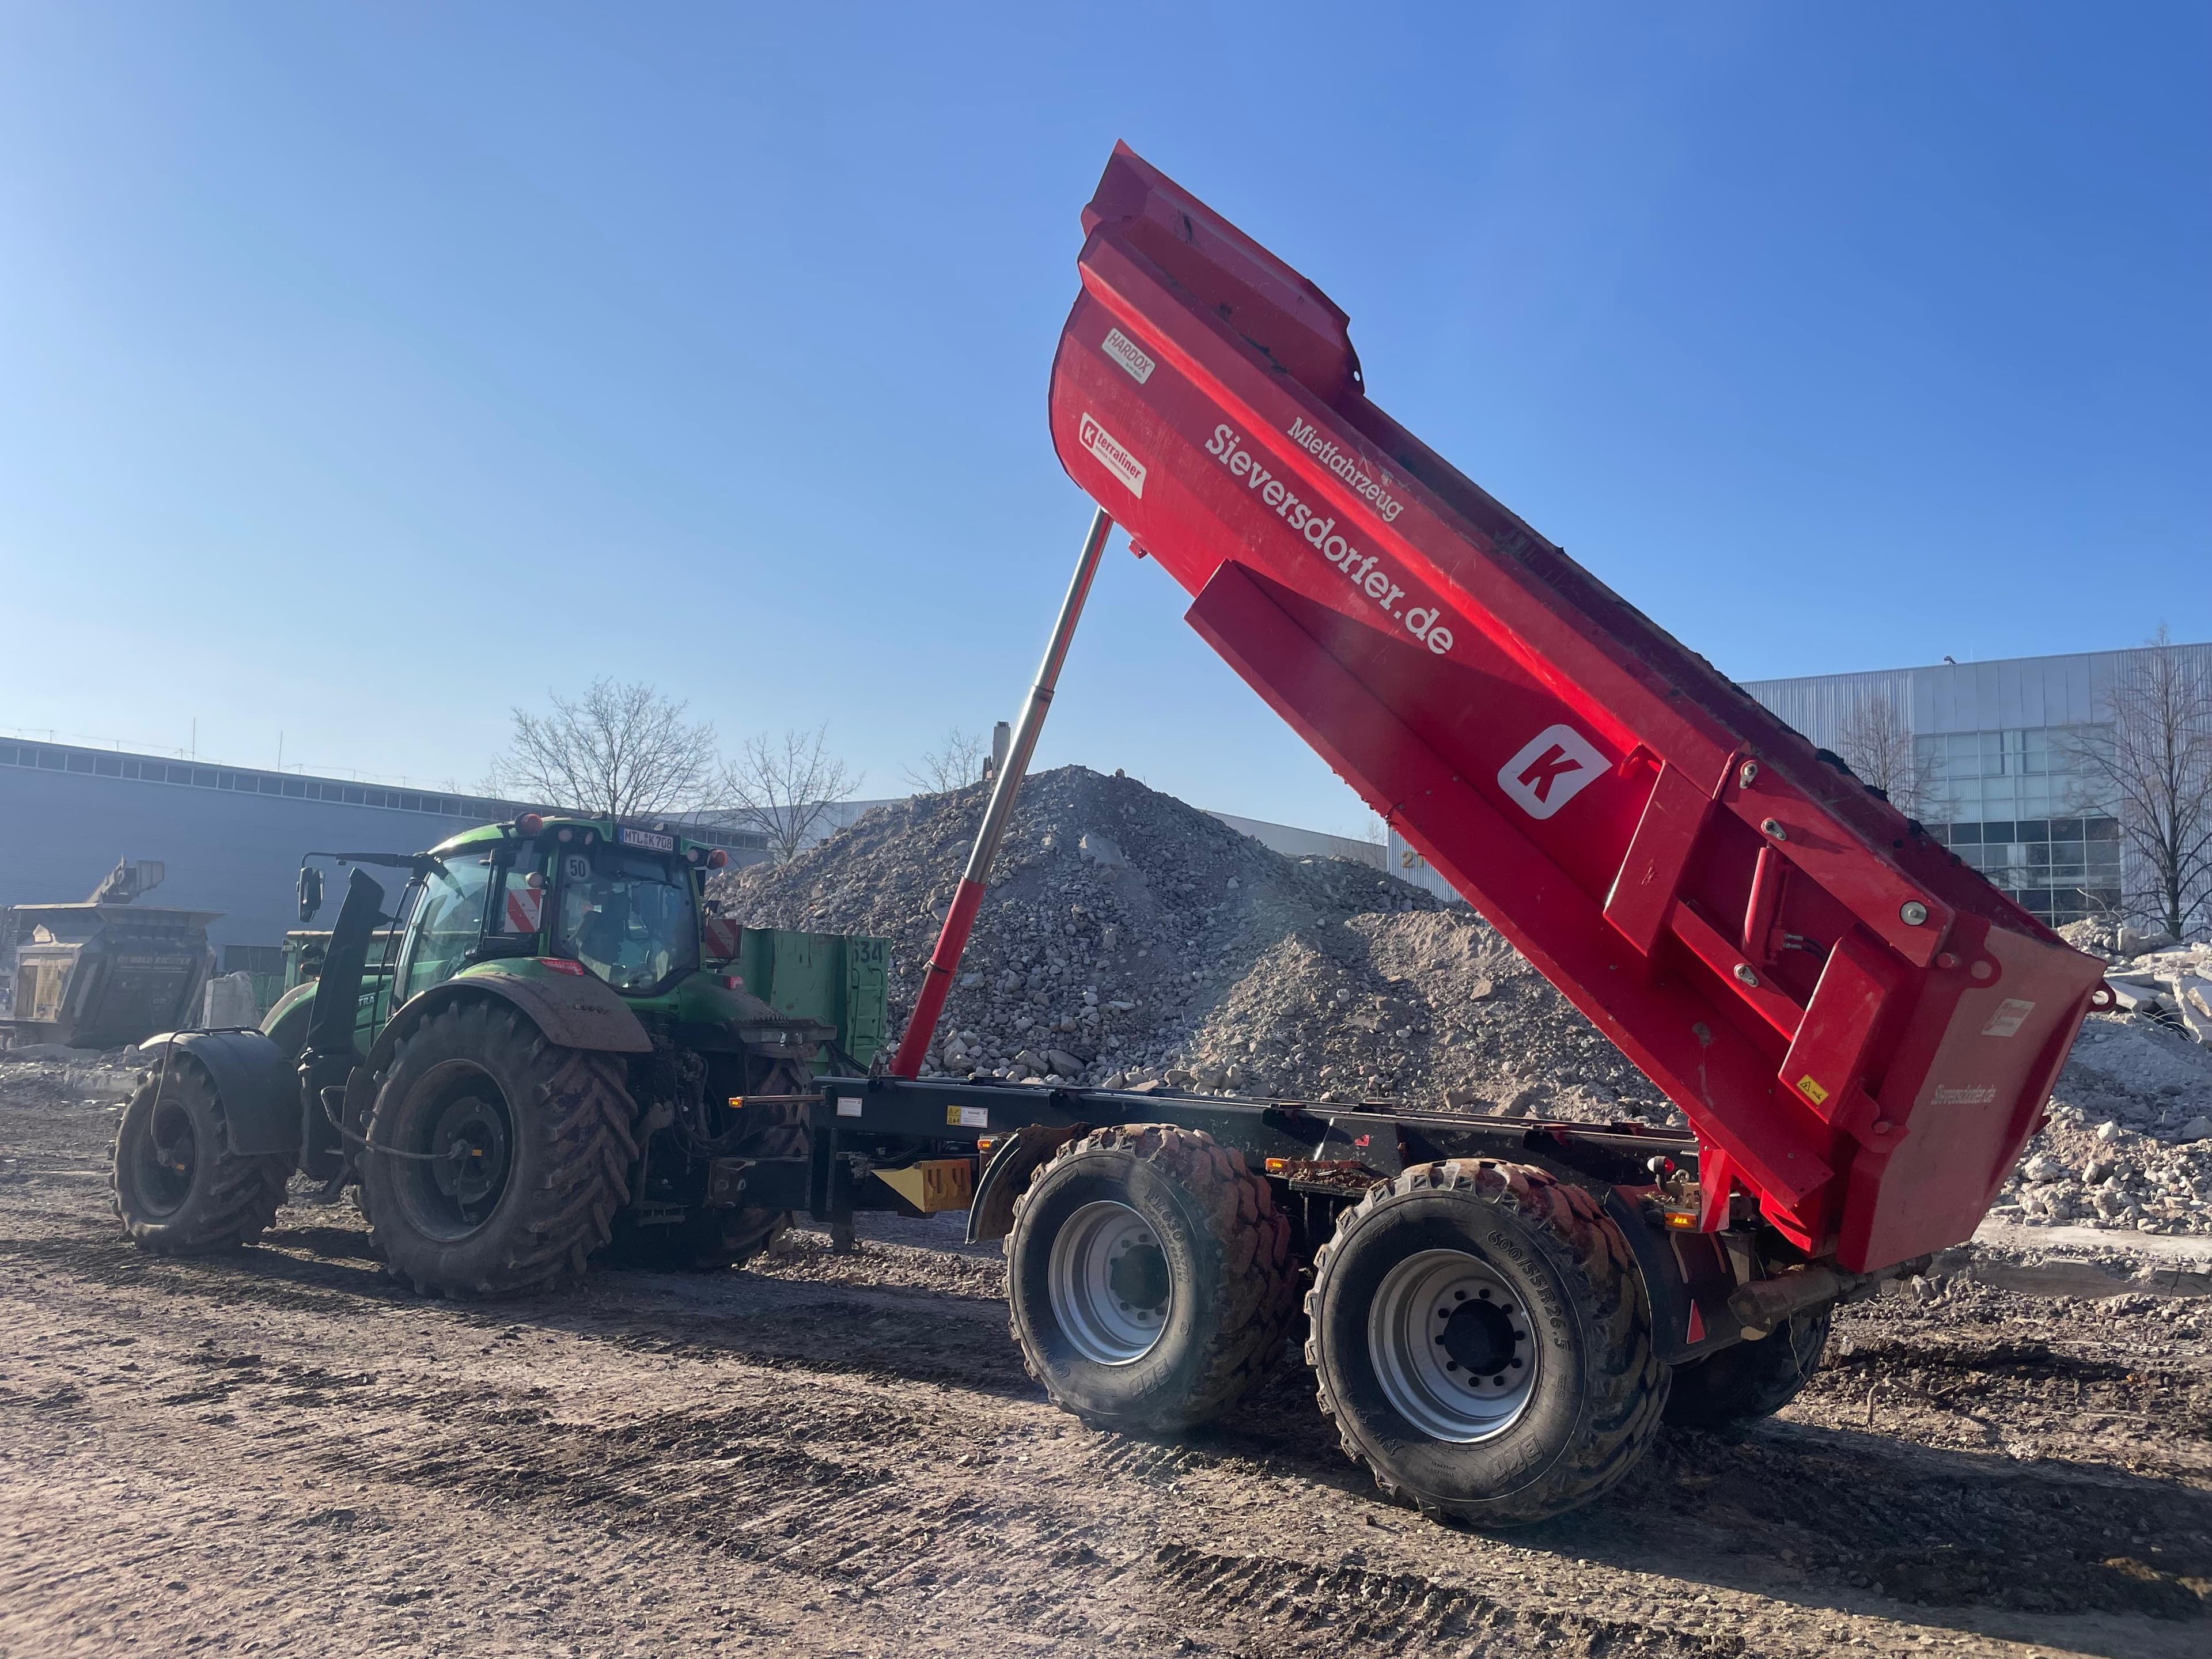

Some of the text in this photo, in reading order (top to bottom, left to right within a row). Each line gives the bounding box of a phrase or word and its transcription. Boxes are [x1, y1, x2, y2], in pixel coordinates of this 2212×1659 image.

[1107, 332, 1152, 374] HARDOX
[1097, 433, 1142, 479] terraliner
[1287, 417, 1404, 522] Mietfahrzeug
[1205, 424, 1453, 655] Sieversdorfer.de
[1517, 743, 1584, 804] K
[625, 830, 643, 844] MTL
[570, 859, 586, 877] 50
[358, 996, 374, 1007] TRA
[1488, 1431, 1543, 1487] BKT
